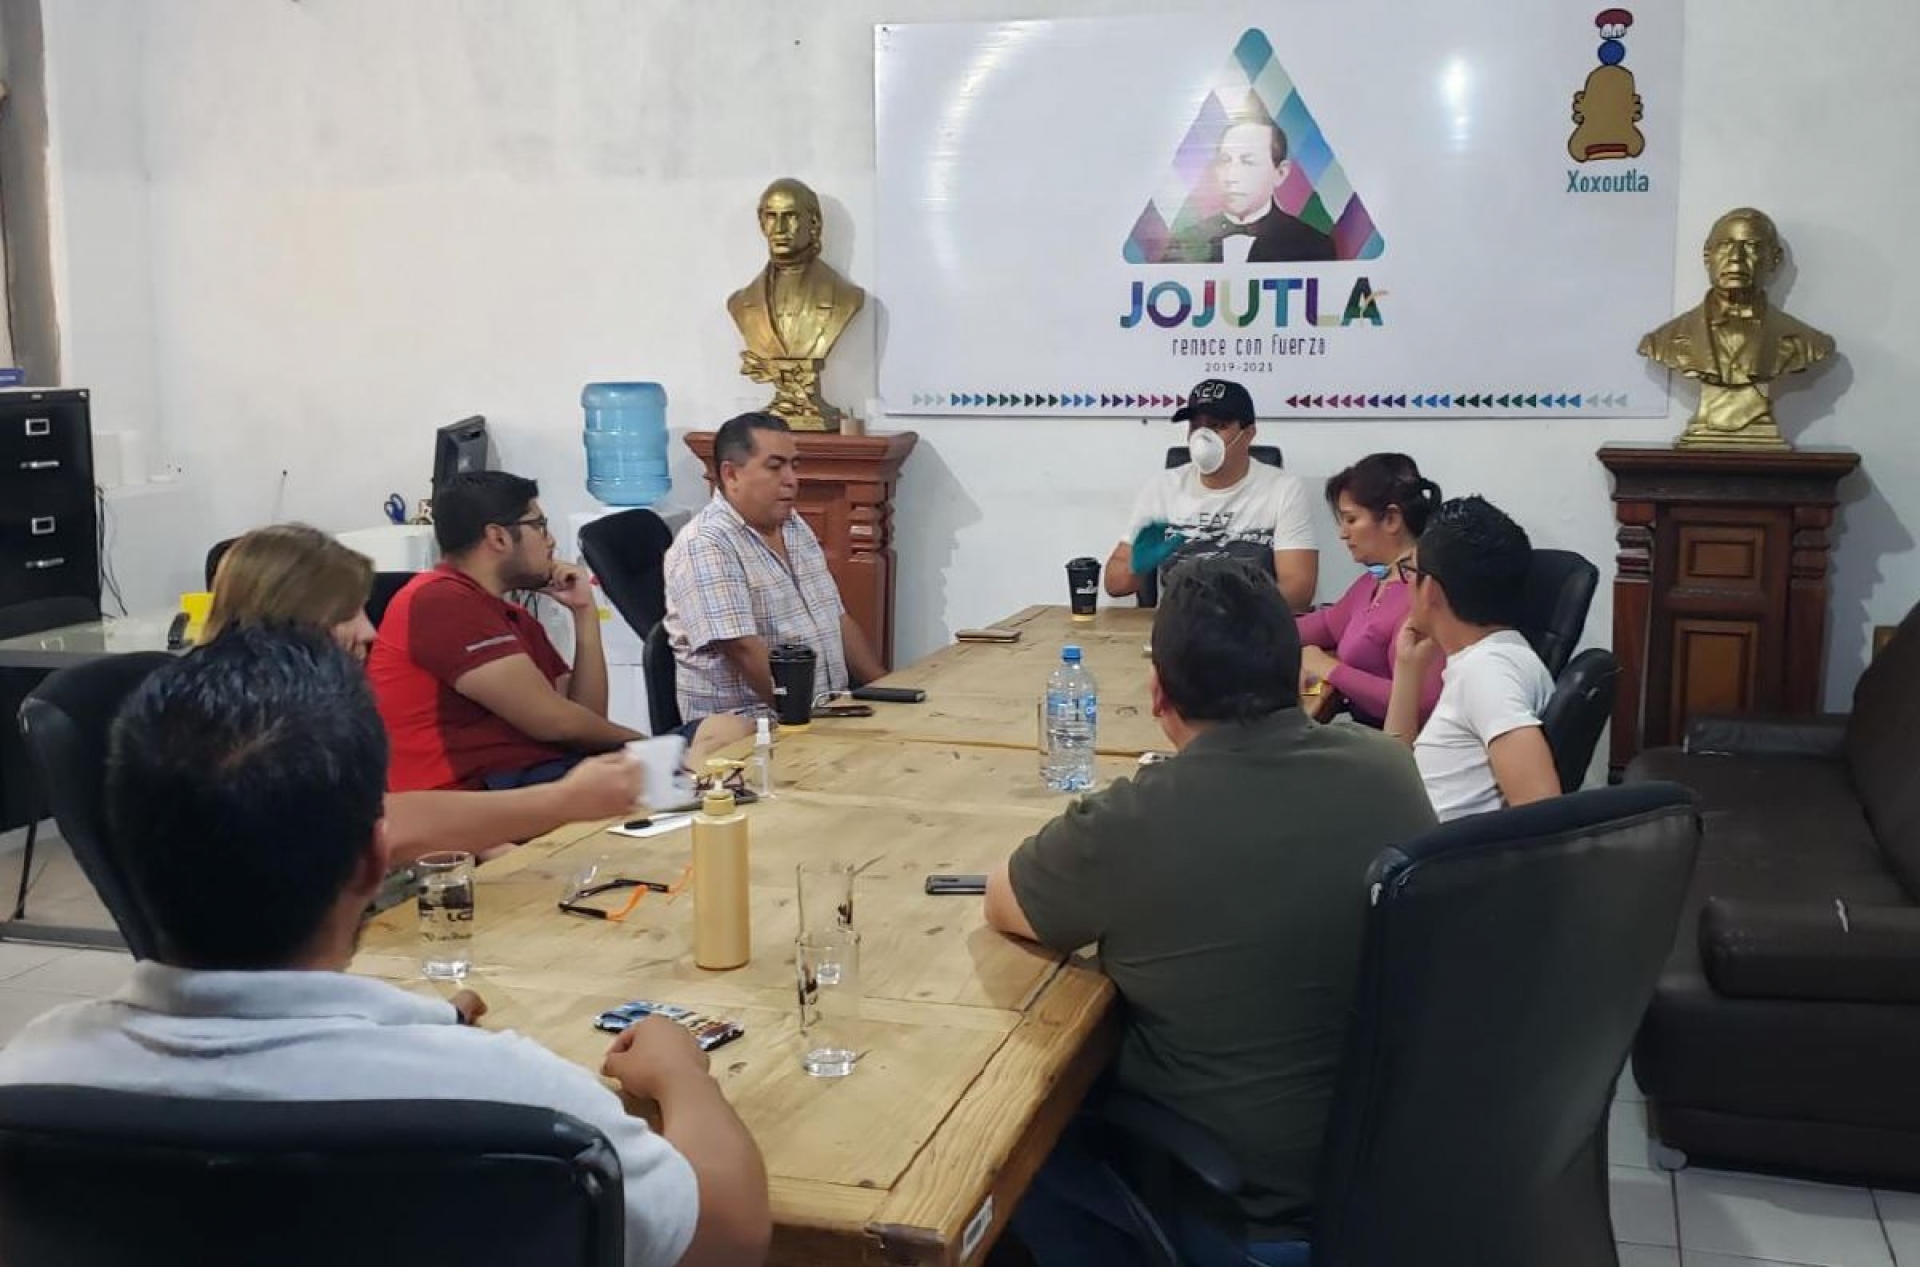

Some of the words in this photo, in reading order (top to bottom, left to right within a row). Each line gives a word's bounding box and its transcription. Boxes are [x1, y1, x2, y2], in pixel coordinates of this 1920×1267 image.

[1566, 168, 1649, 192] Xoxoutla
[1120, 277, 1384, 328] JOJUTLA
[1172, 335, 1226, 356] renace
[1236, 336, 1262, 356] con
[1271, 333, 1326, 356] fuerza
[1204, 362, 1273, 372] 2019-2021
